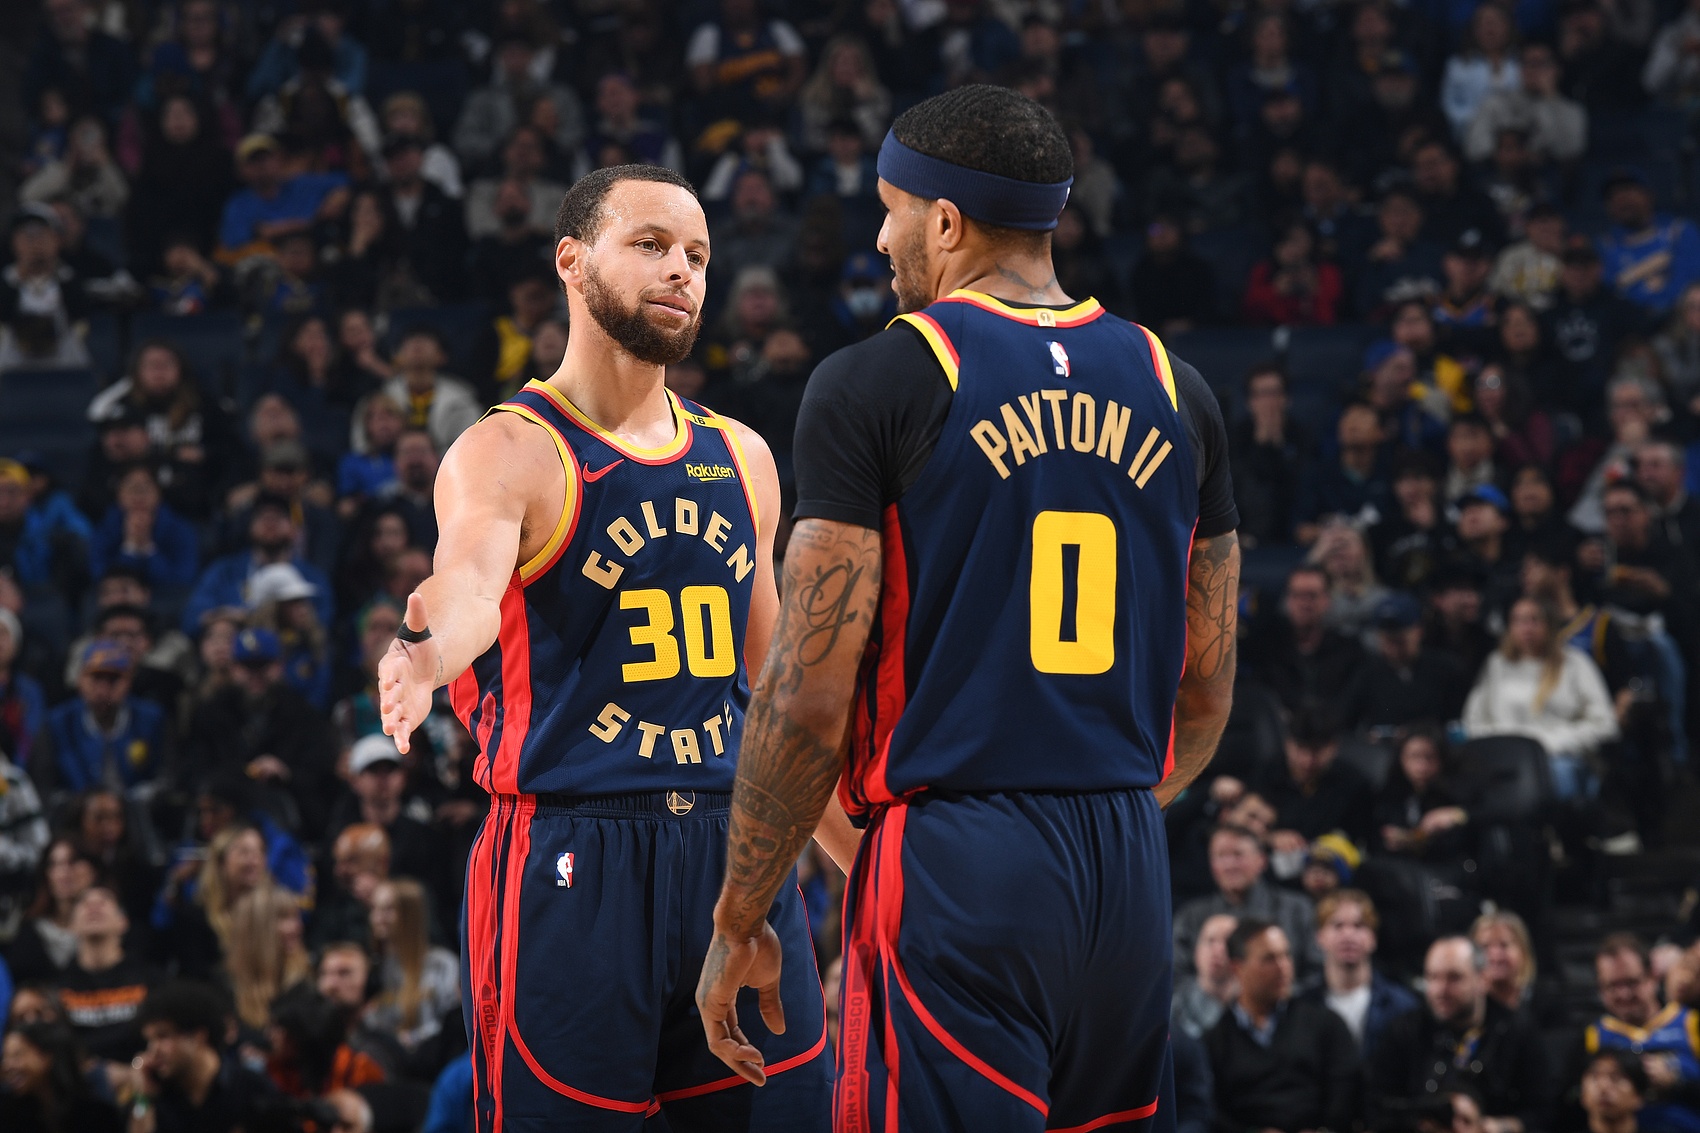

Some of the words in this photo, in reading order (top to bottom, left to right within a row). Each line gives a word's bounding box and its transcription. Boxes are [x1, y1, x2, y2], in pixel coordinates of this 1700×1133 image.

[685, 463, 736, 479] Rakuten
[969, 389, 1132, 480] PAYTON
[1127, 426, 1173, 490] II
[581, 497, 755, 590] GOLDEN
[619, 585, 736, 683] 30
[1029, 509, 1117, 675] 0
[847, 996, 864, 1086] FRANCISCO
